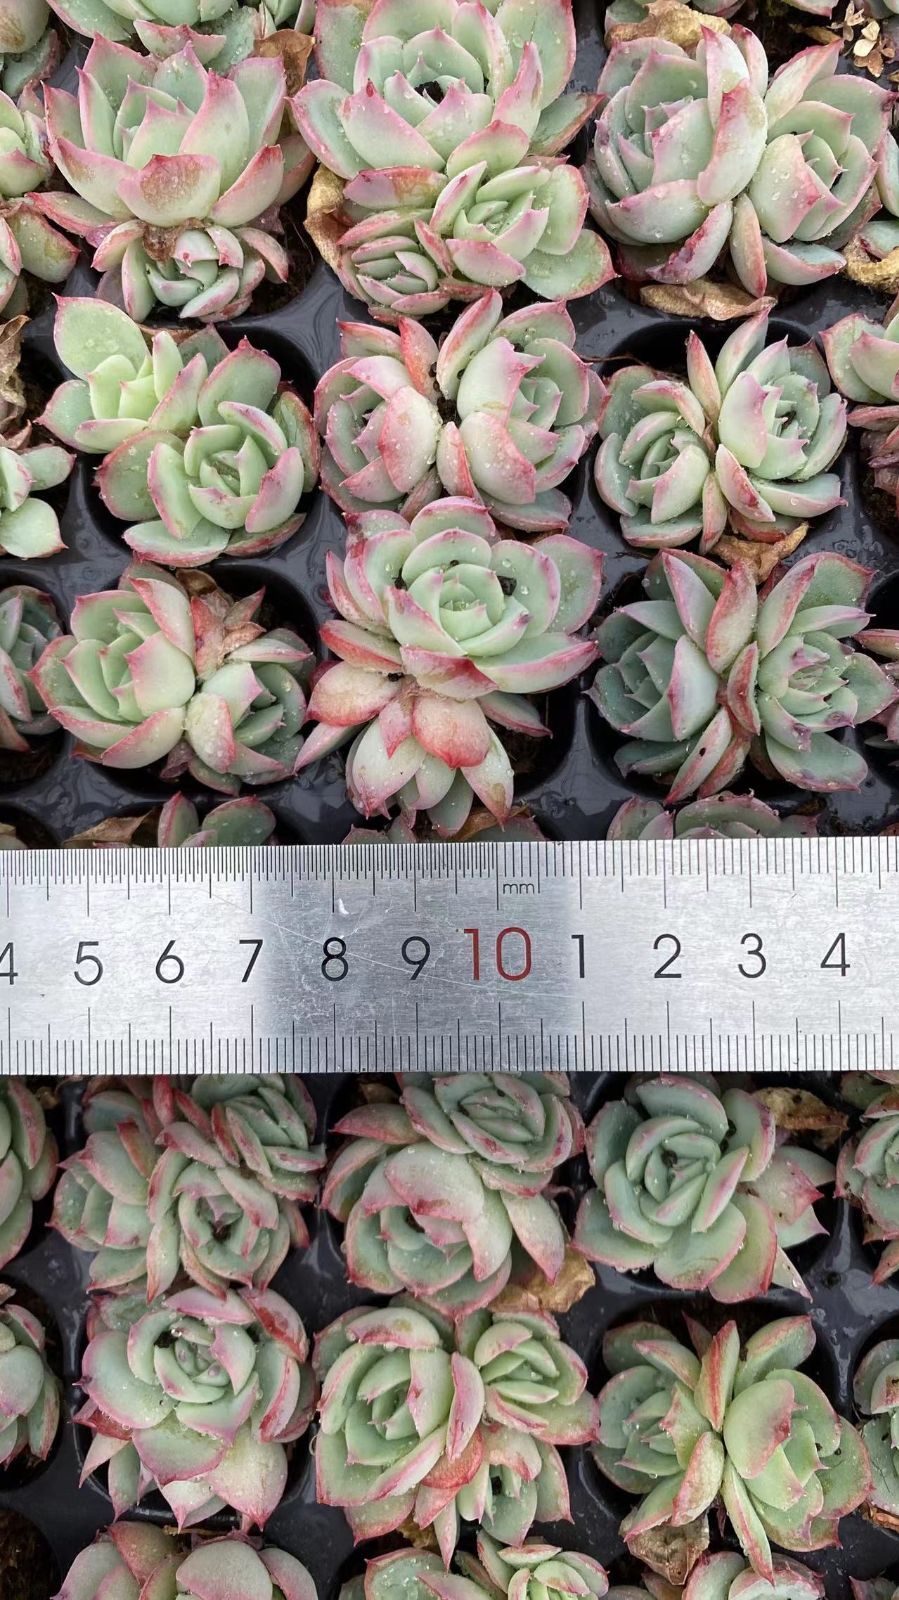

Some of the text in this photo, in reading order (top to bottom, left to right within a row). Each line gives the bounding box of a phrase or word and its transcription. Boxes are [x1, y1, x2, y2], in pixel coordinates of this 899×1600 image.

[502, 882, 535, 895] mm
[73, 941, 104, 986] 5
[155, 939, 185, 984] 6
[238, 938, 264, 983] 7
[320, 936, 349, 982] 8
[401, 935, 431, 981] 9
[463, 926, 532, 982] 10
[571, 934, 586, 979] 1
[652, 933, 683, 979] 2
[737, 932, 767, 979] 3
[819, 932, 851, 977] 4
